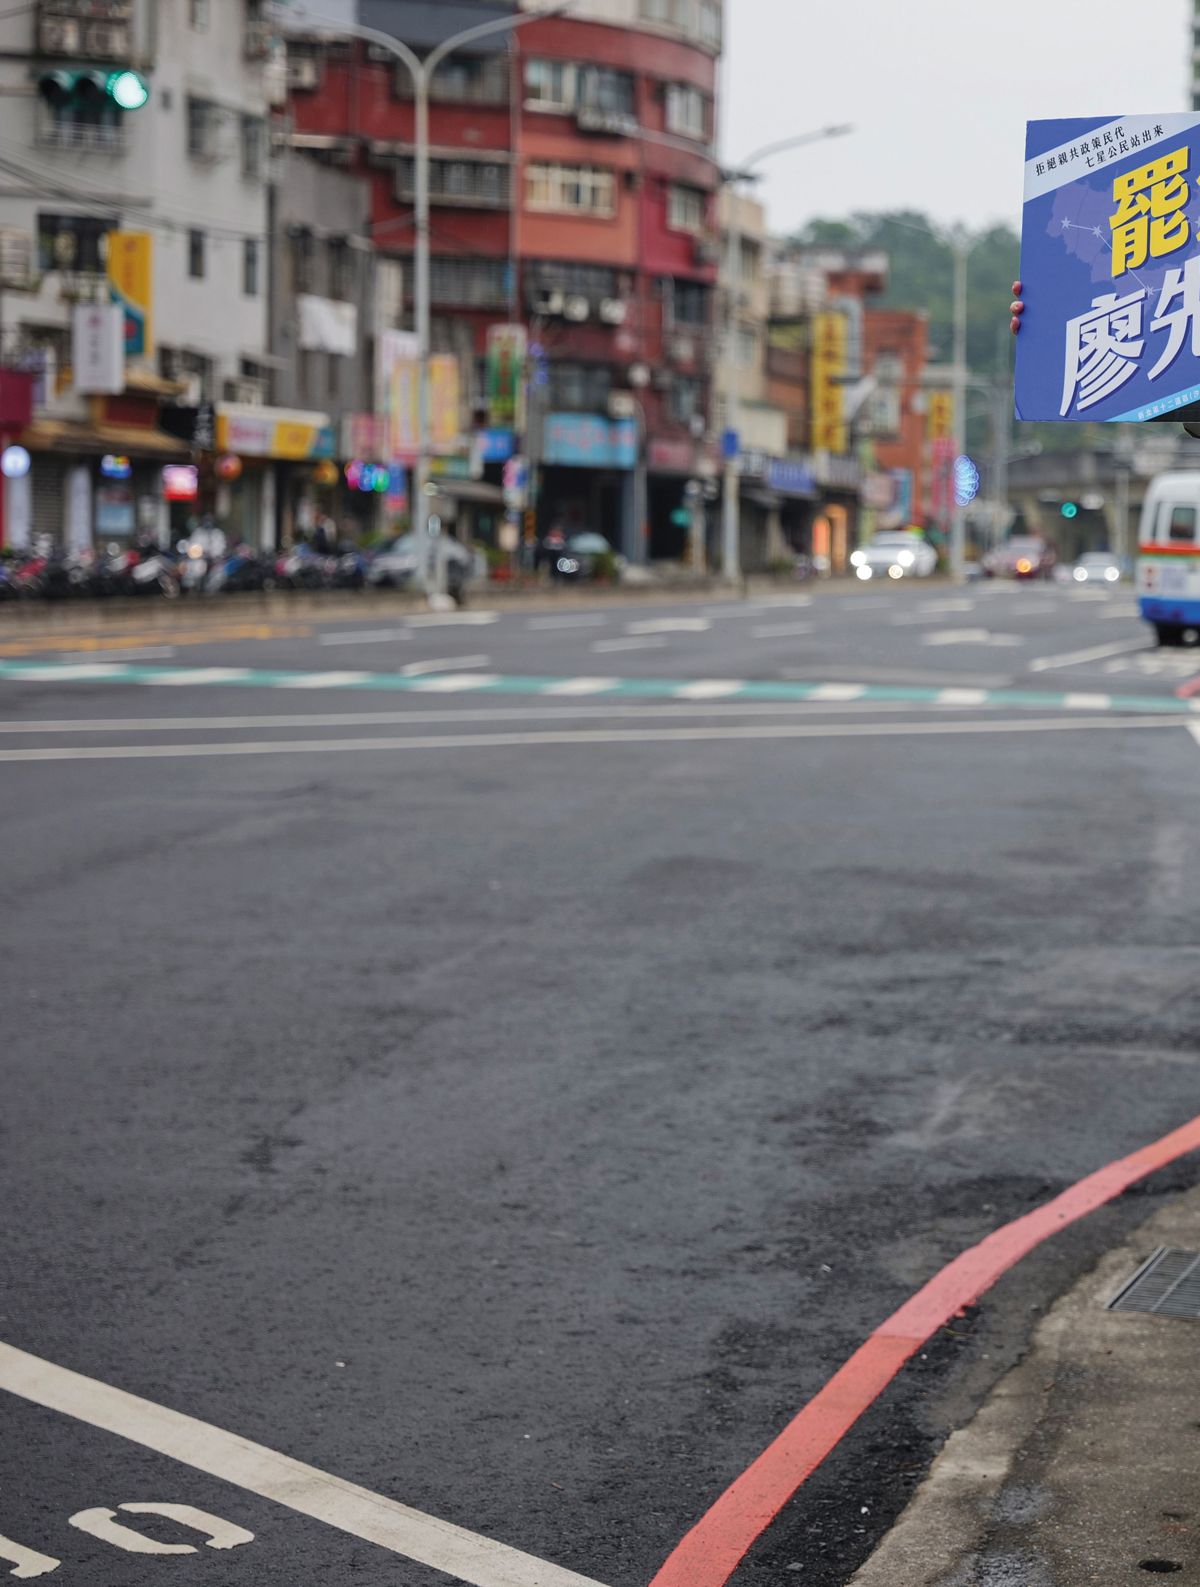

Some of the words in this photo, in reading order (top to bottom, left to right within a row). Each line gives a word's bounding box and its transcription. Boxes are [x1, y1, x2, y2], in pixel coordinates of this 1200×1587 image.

[1036, 126, 1126, 176] 拒絕親共政策民代
[1084, 124, 1164, 168] 七星公民站出來
